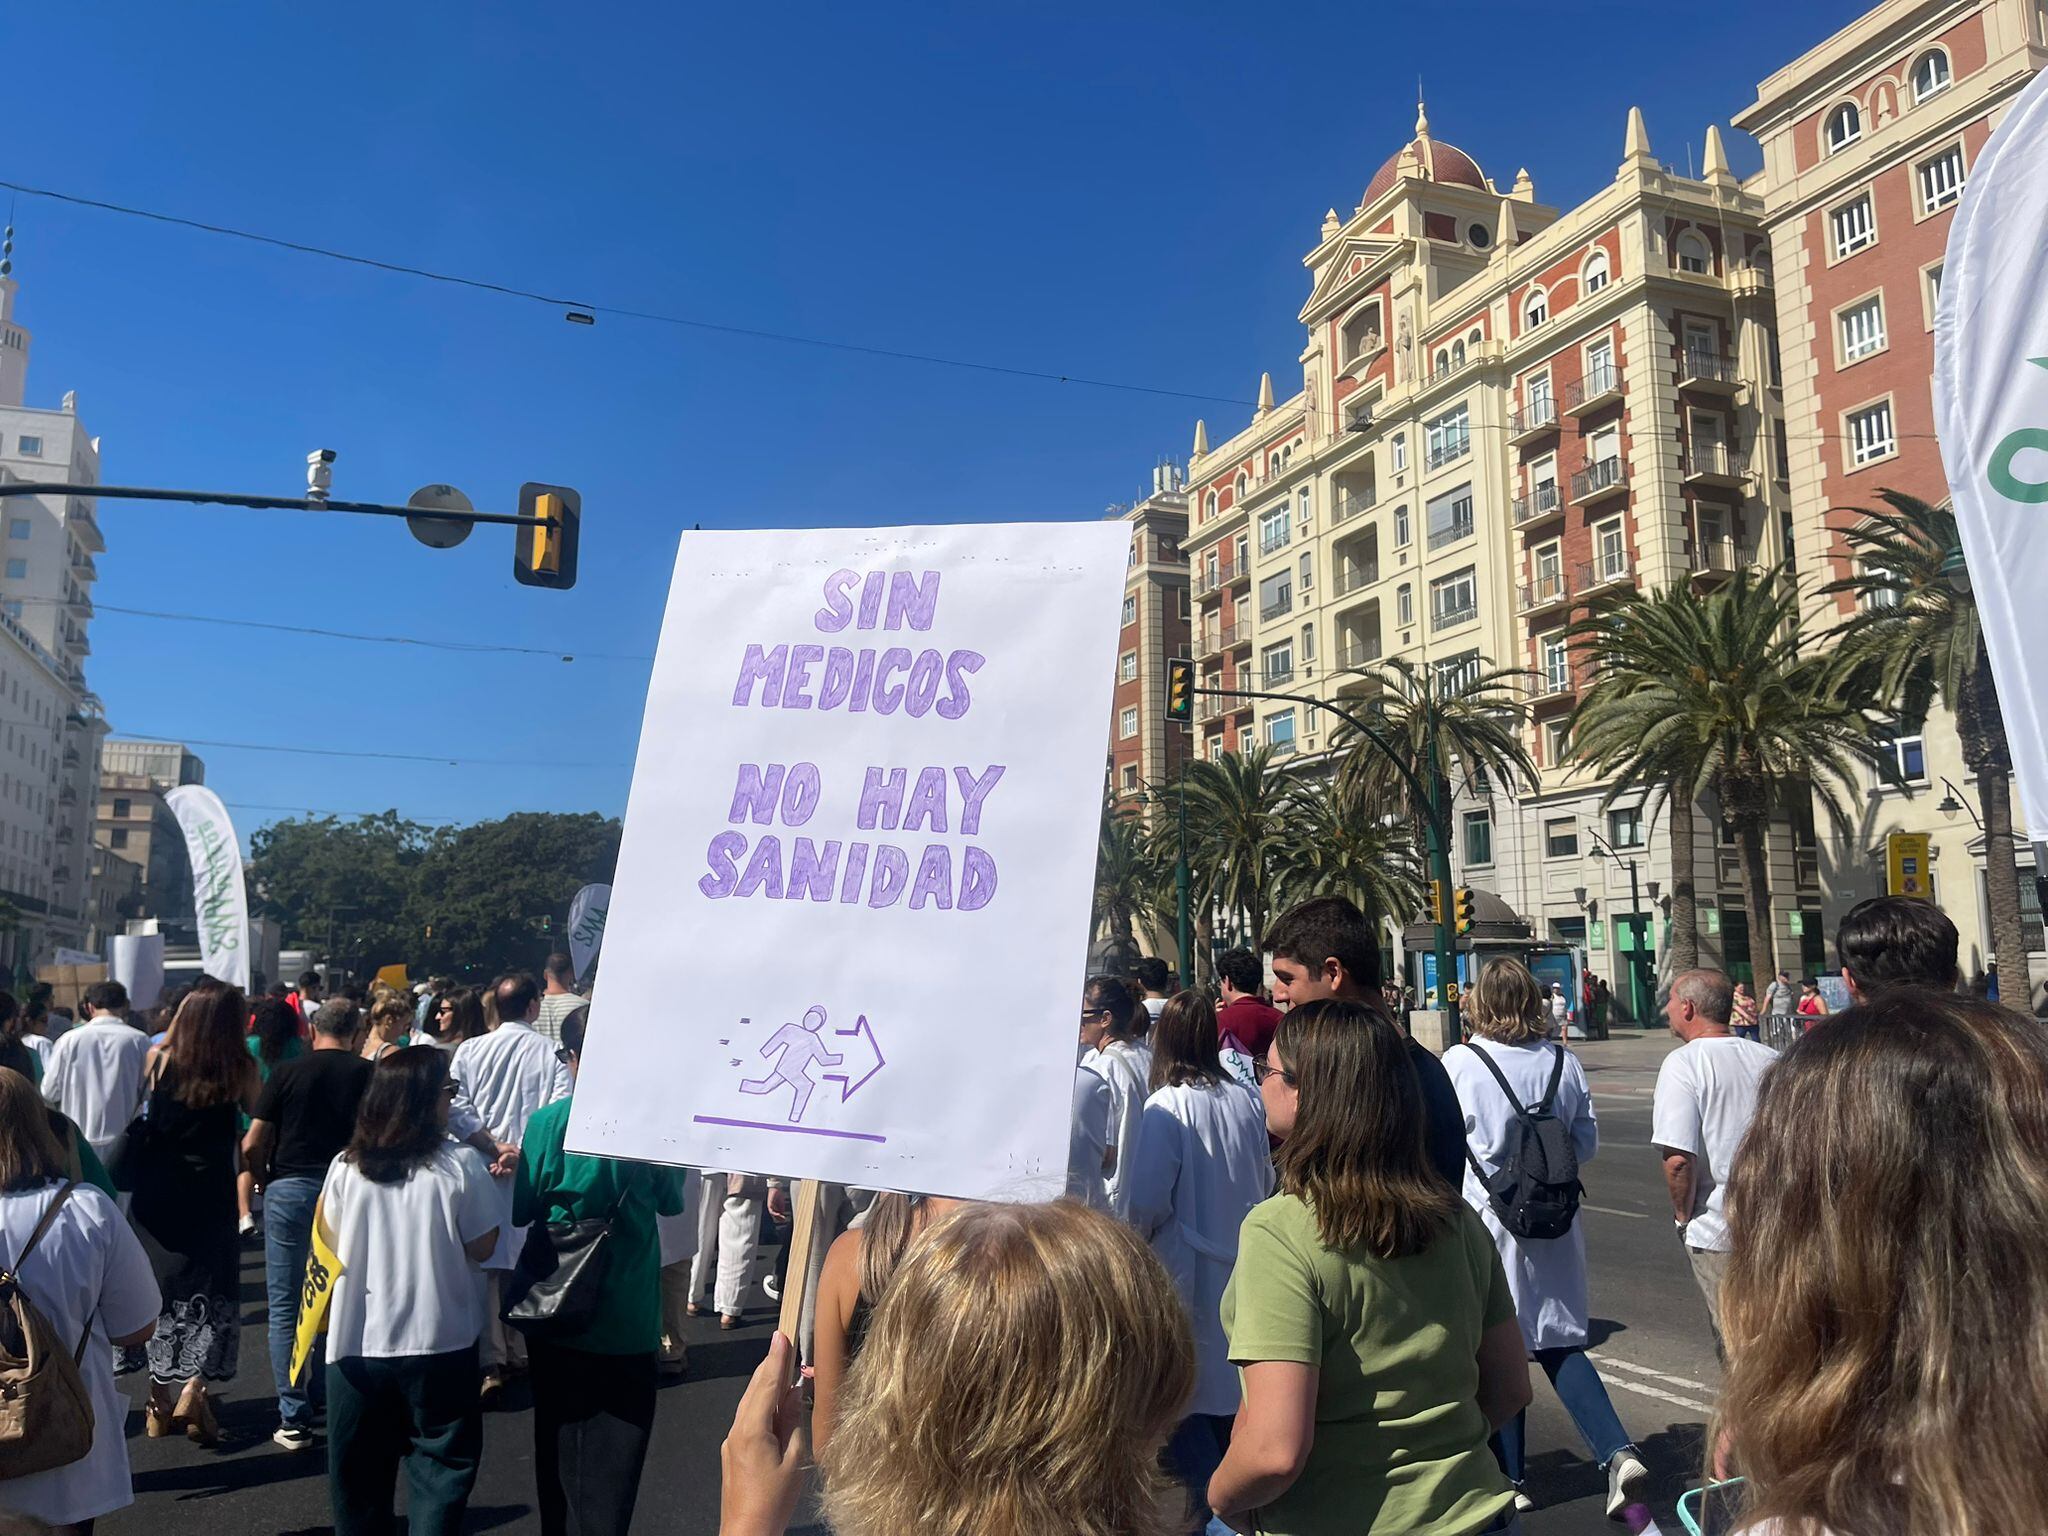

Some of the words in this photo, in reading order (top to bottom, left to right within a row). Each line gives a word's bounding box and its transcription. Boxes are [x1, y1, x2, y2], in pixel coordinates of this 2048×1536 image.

[815, 569, 941, 635] SIN
[732, 644, 988, 720] MEDICOS
[728, 761, 822, 829] NO
[856, 765, 1008, 836] HAY
[698, 830, 998, 912] SANIDAD
